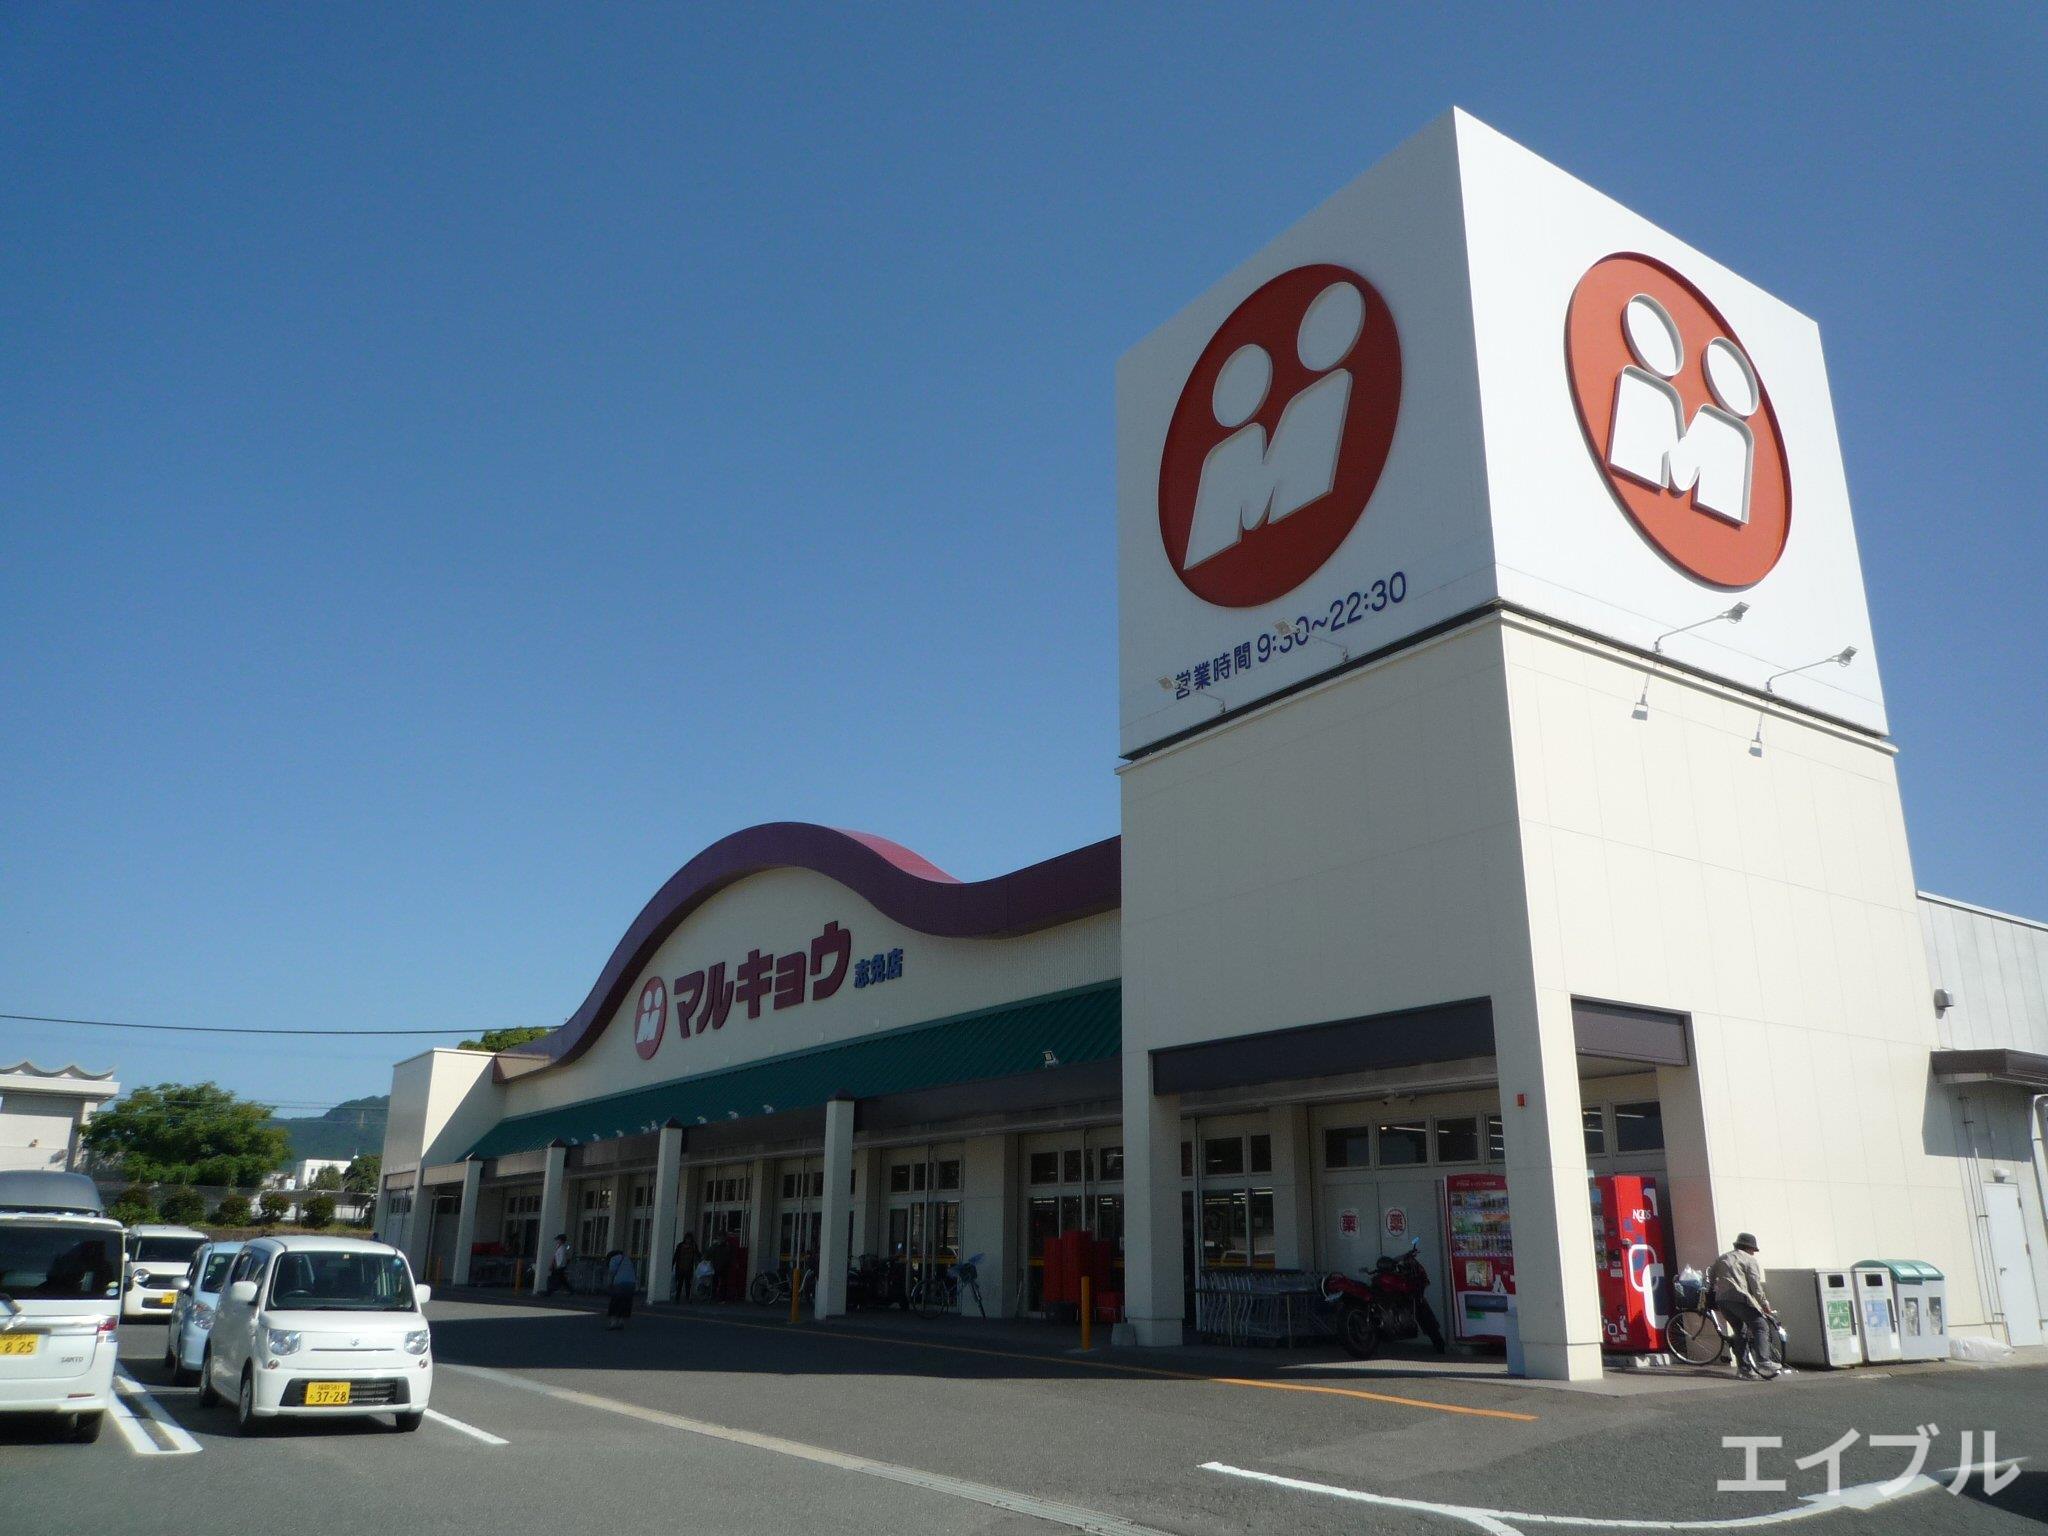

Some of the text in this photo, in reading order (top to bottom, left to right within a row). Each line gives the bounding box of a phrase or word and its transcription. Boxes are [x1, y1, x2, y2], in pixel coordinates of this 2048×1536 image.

[1175, 641, 1251, 700] 営業時間
[674, 920, 852, 1040] マルキョウ
